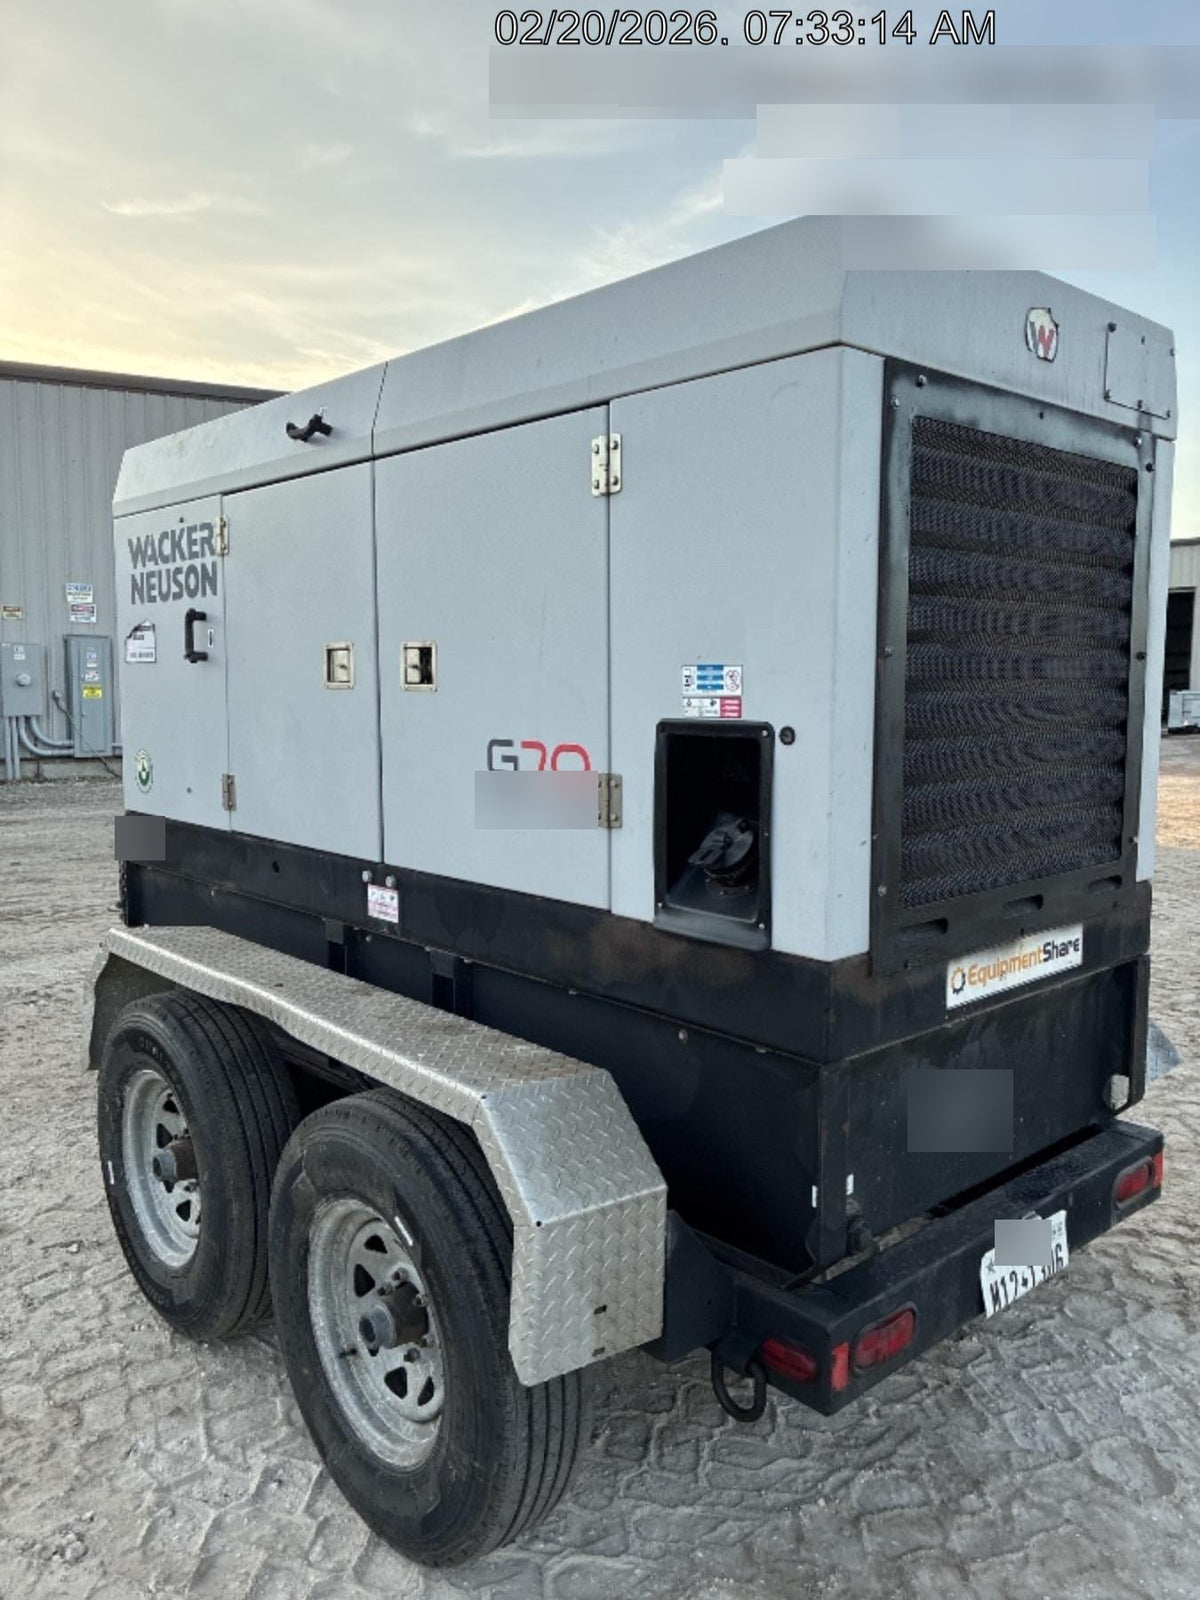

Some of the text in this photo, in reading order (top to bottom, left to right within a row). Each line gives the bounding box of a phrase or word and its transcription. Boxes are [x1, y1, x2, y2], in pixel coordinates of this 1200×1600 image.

[127, 522, 216, 570] WACKER
[131, 561, 217, 605] NEUSON
[487, 739, 591, 771] G70
[967, 938, 1080, 987] EquipmentShare
